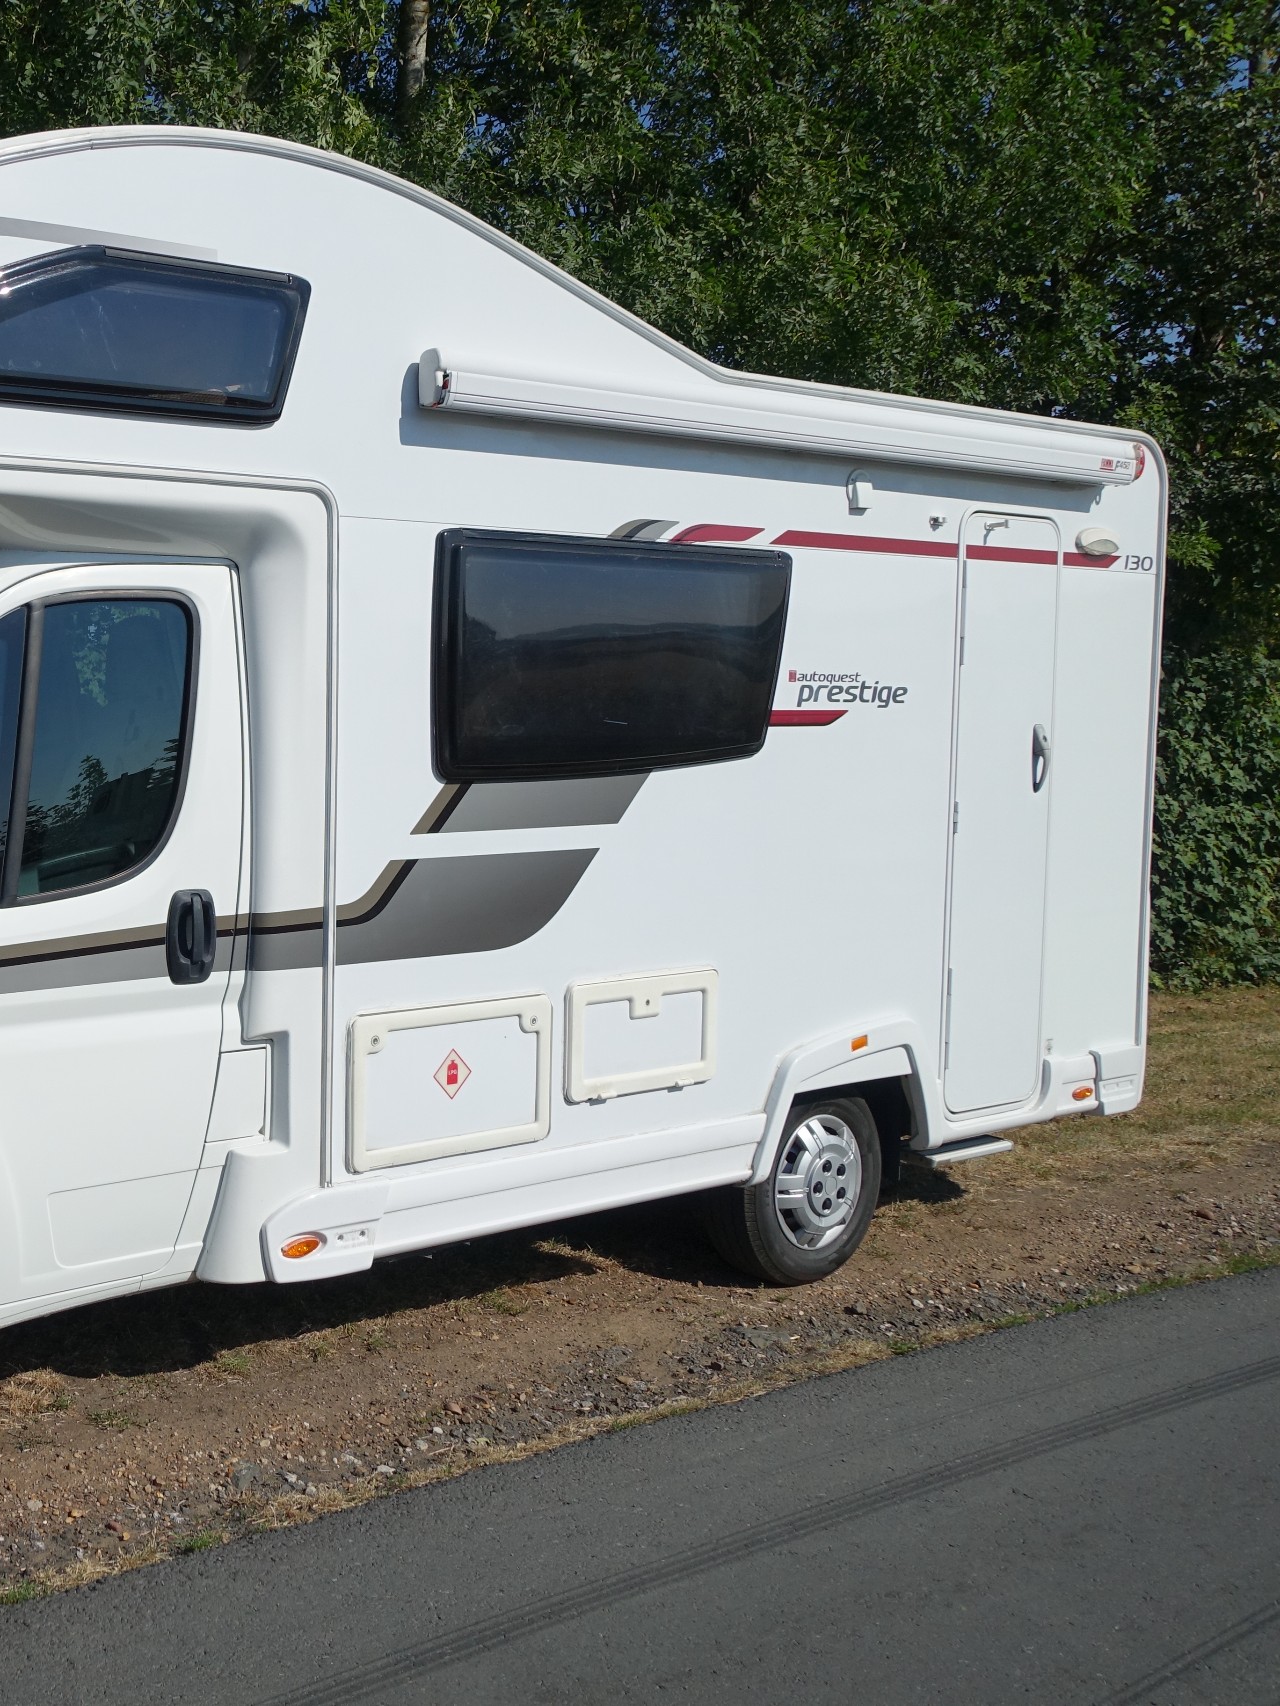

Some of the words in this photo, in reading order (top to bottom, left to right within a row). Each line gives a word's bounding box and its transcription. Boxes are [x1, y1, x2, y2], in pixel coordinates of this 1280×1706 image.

[1124, 554, 1153, 571] 130
[797, 671, 861, 684] autoquest
[796, 681, 908, 708] prestige
